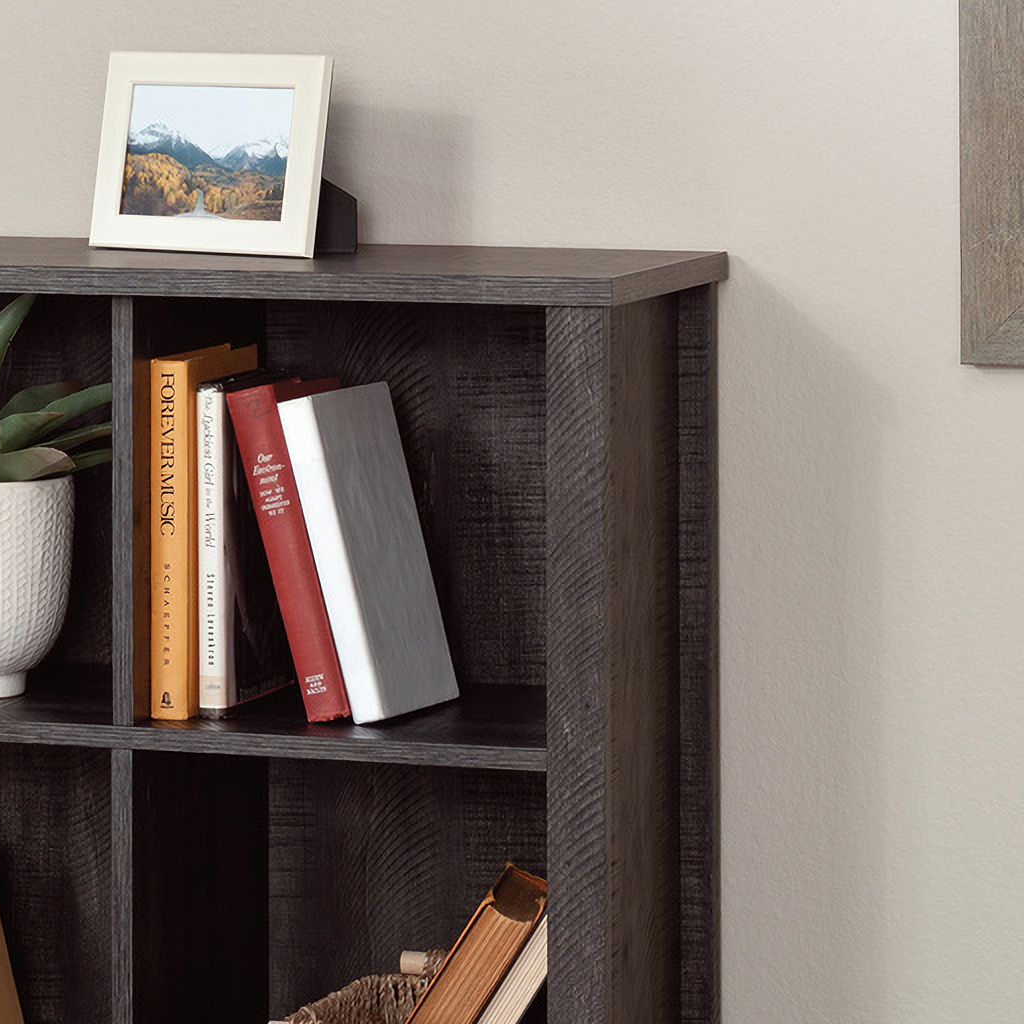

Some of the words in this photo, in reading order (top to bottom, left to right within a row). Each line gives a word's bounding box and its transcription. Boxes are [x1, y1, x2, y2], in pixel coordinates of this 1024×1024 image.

[160, 372, 175, 470] FOREVER
[203, 462, 214, 485] Girl
[160, 472, 175, 535] MUSIC
[204, 513, 215, 548] World
